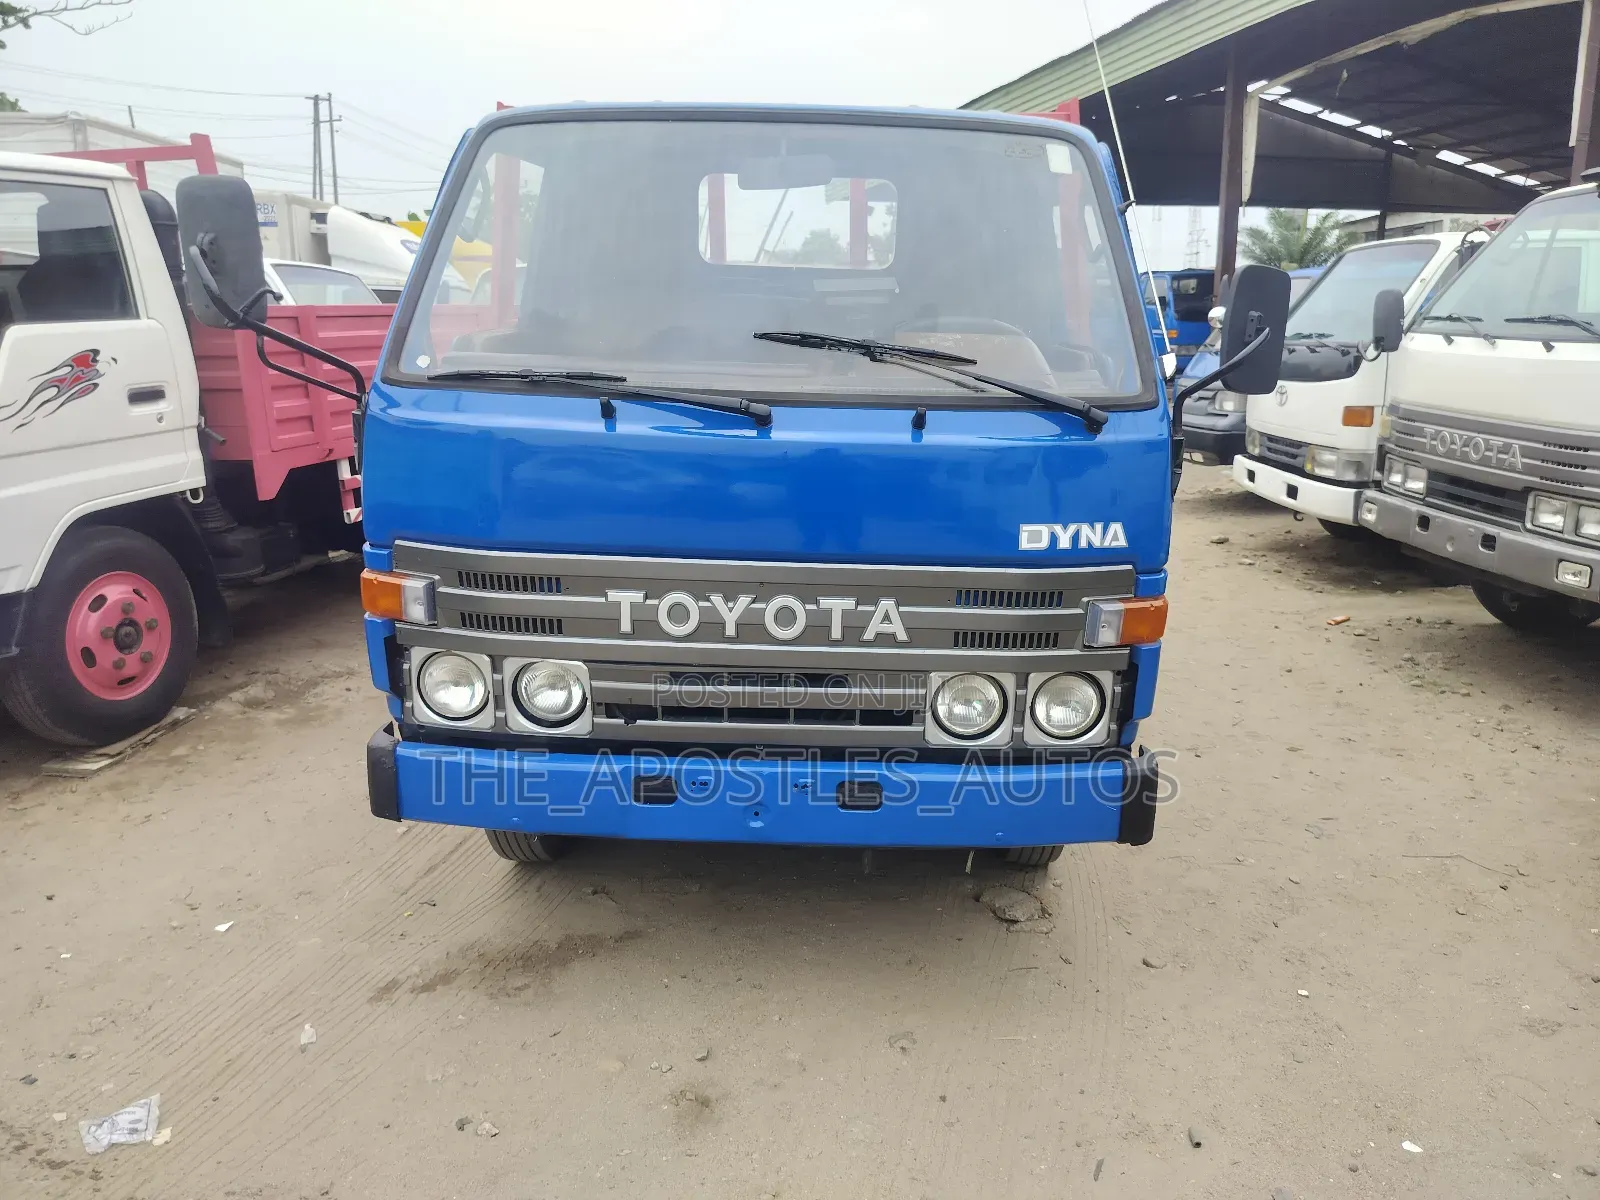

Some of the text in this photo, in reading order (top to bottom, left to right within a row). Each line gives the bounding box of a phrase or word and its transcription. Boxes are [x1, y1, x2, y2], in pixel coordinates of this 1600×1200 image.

[1423, 427, 1523, 471] TOYOTA
[1018, 521, 1129, 551] DYNA
[605, 589, 911, 643] TOYOTA
